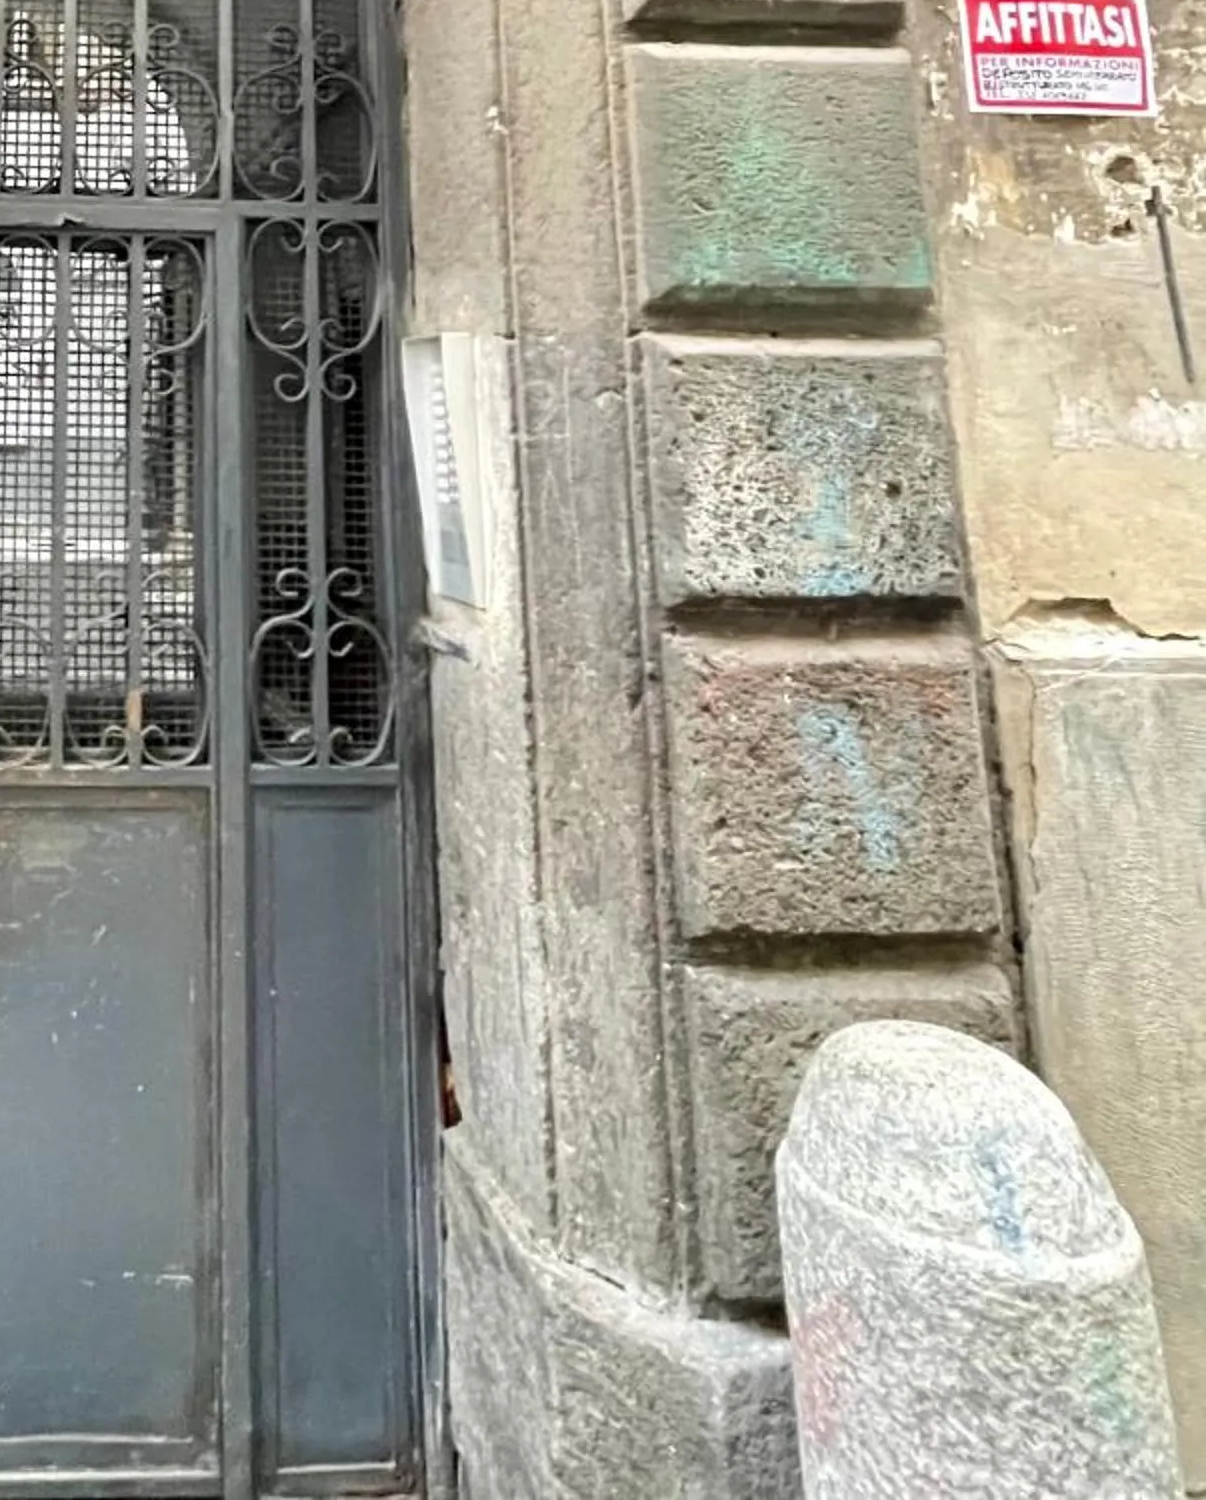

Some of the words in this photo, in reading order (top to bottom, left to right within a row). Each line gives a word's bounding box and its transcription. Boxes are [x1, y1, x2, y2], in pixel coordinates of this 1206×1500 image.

[977, 1, 1137, 48] AFFITTASI
[980, 56, 1007, 67] PER
[1015, 57, 1139, 70] INFORMAZIONI
